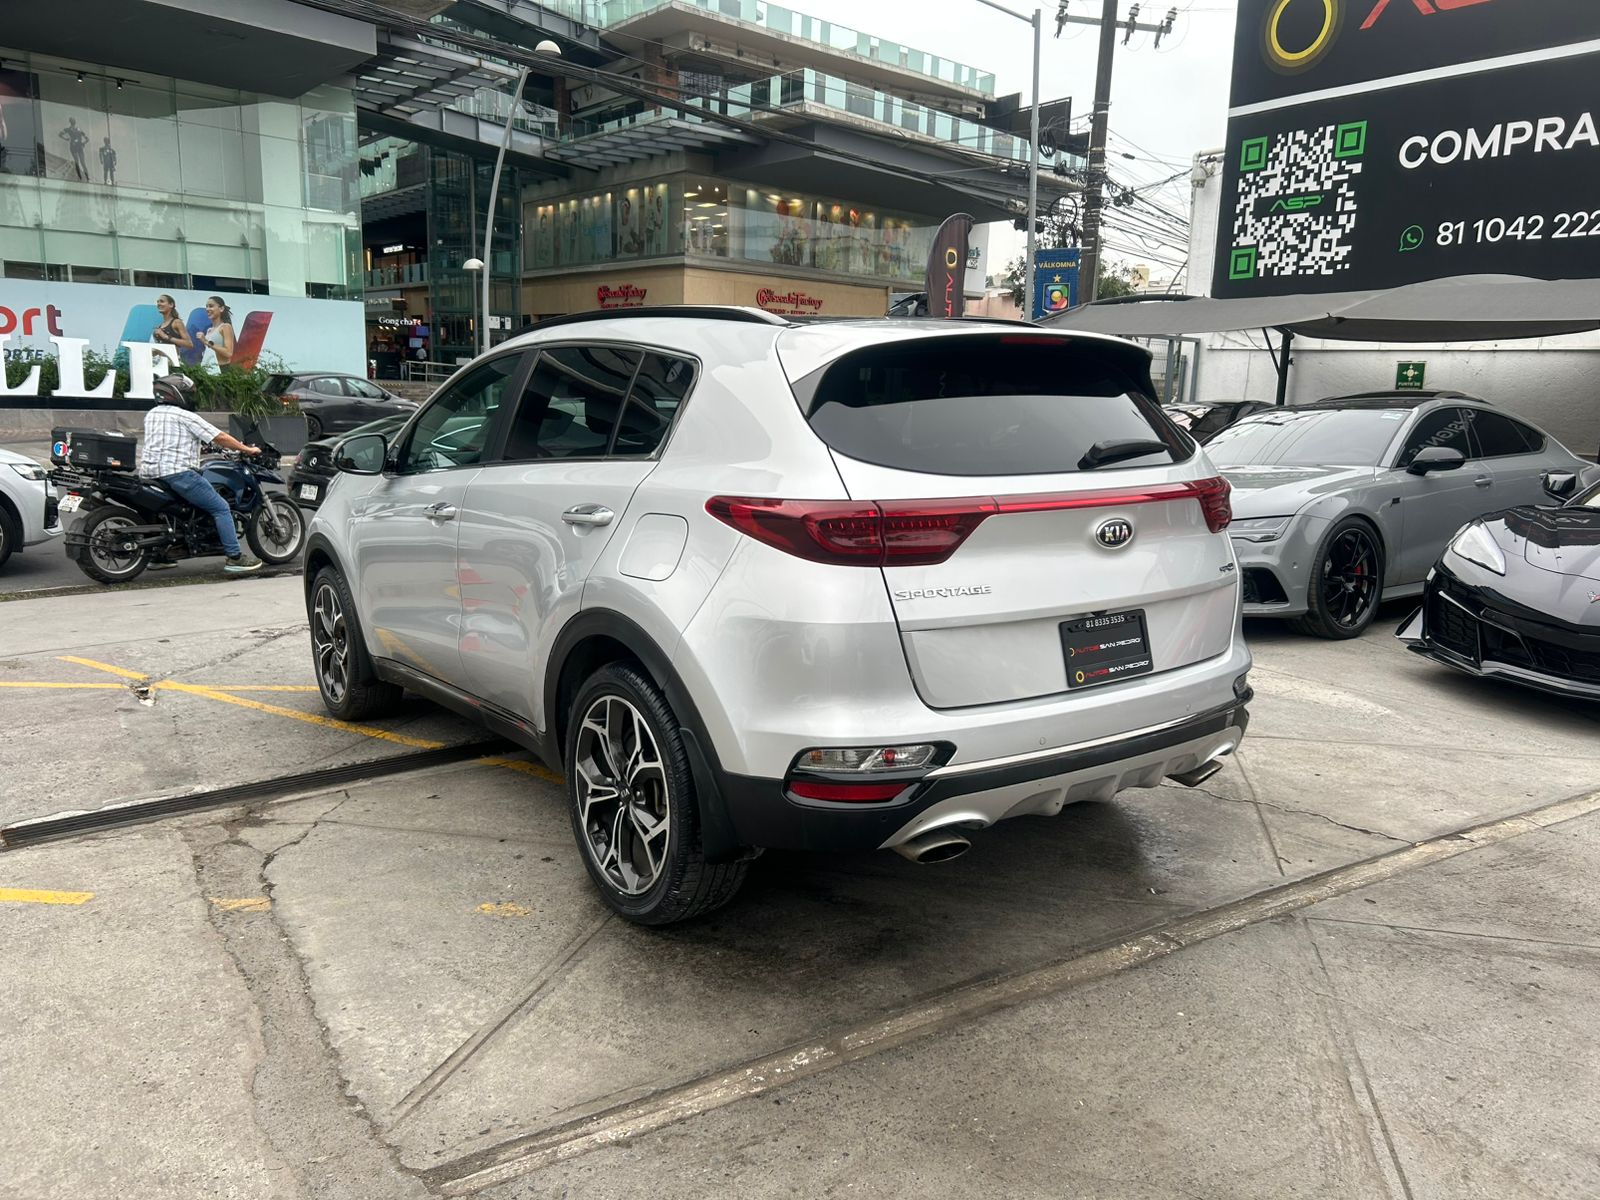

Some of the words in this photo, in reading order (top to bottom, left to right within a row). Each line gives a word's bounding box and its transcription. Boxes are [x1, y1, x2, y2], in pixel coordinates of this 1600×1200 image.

[1398, 112, 1600, 169] COMPRA
[1269, 195, 1322, 212] ASP
[1436, 221, 1464, 246] 81
[1472, 214, 1544, 242] 1042
[378, 316, 400, 326] Gong
[1104, 524, 1129, 542] KIA
[894, 584, 993, 602] SPORTAGE
[1085, 620, 1094, 628] 81
[1094, 617, 1110, 627] 8335
[1110, 615, 1125, 624] 3535
[1099, 642, 1116, 650] SAN
[1116, 637, 1141, 647] PEDRO
[1124, 660, 1149, 669] PEDRO
